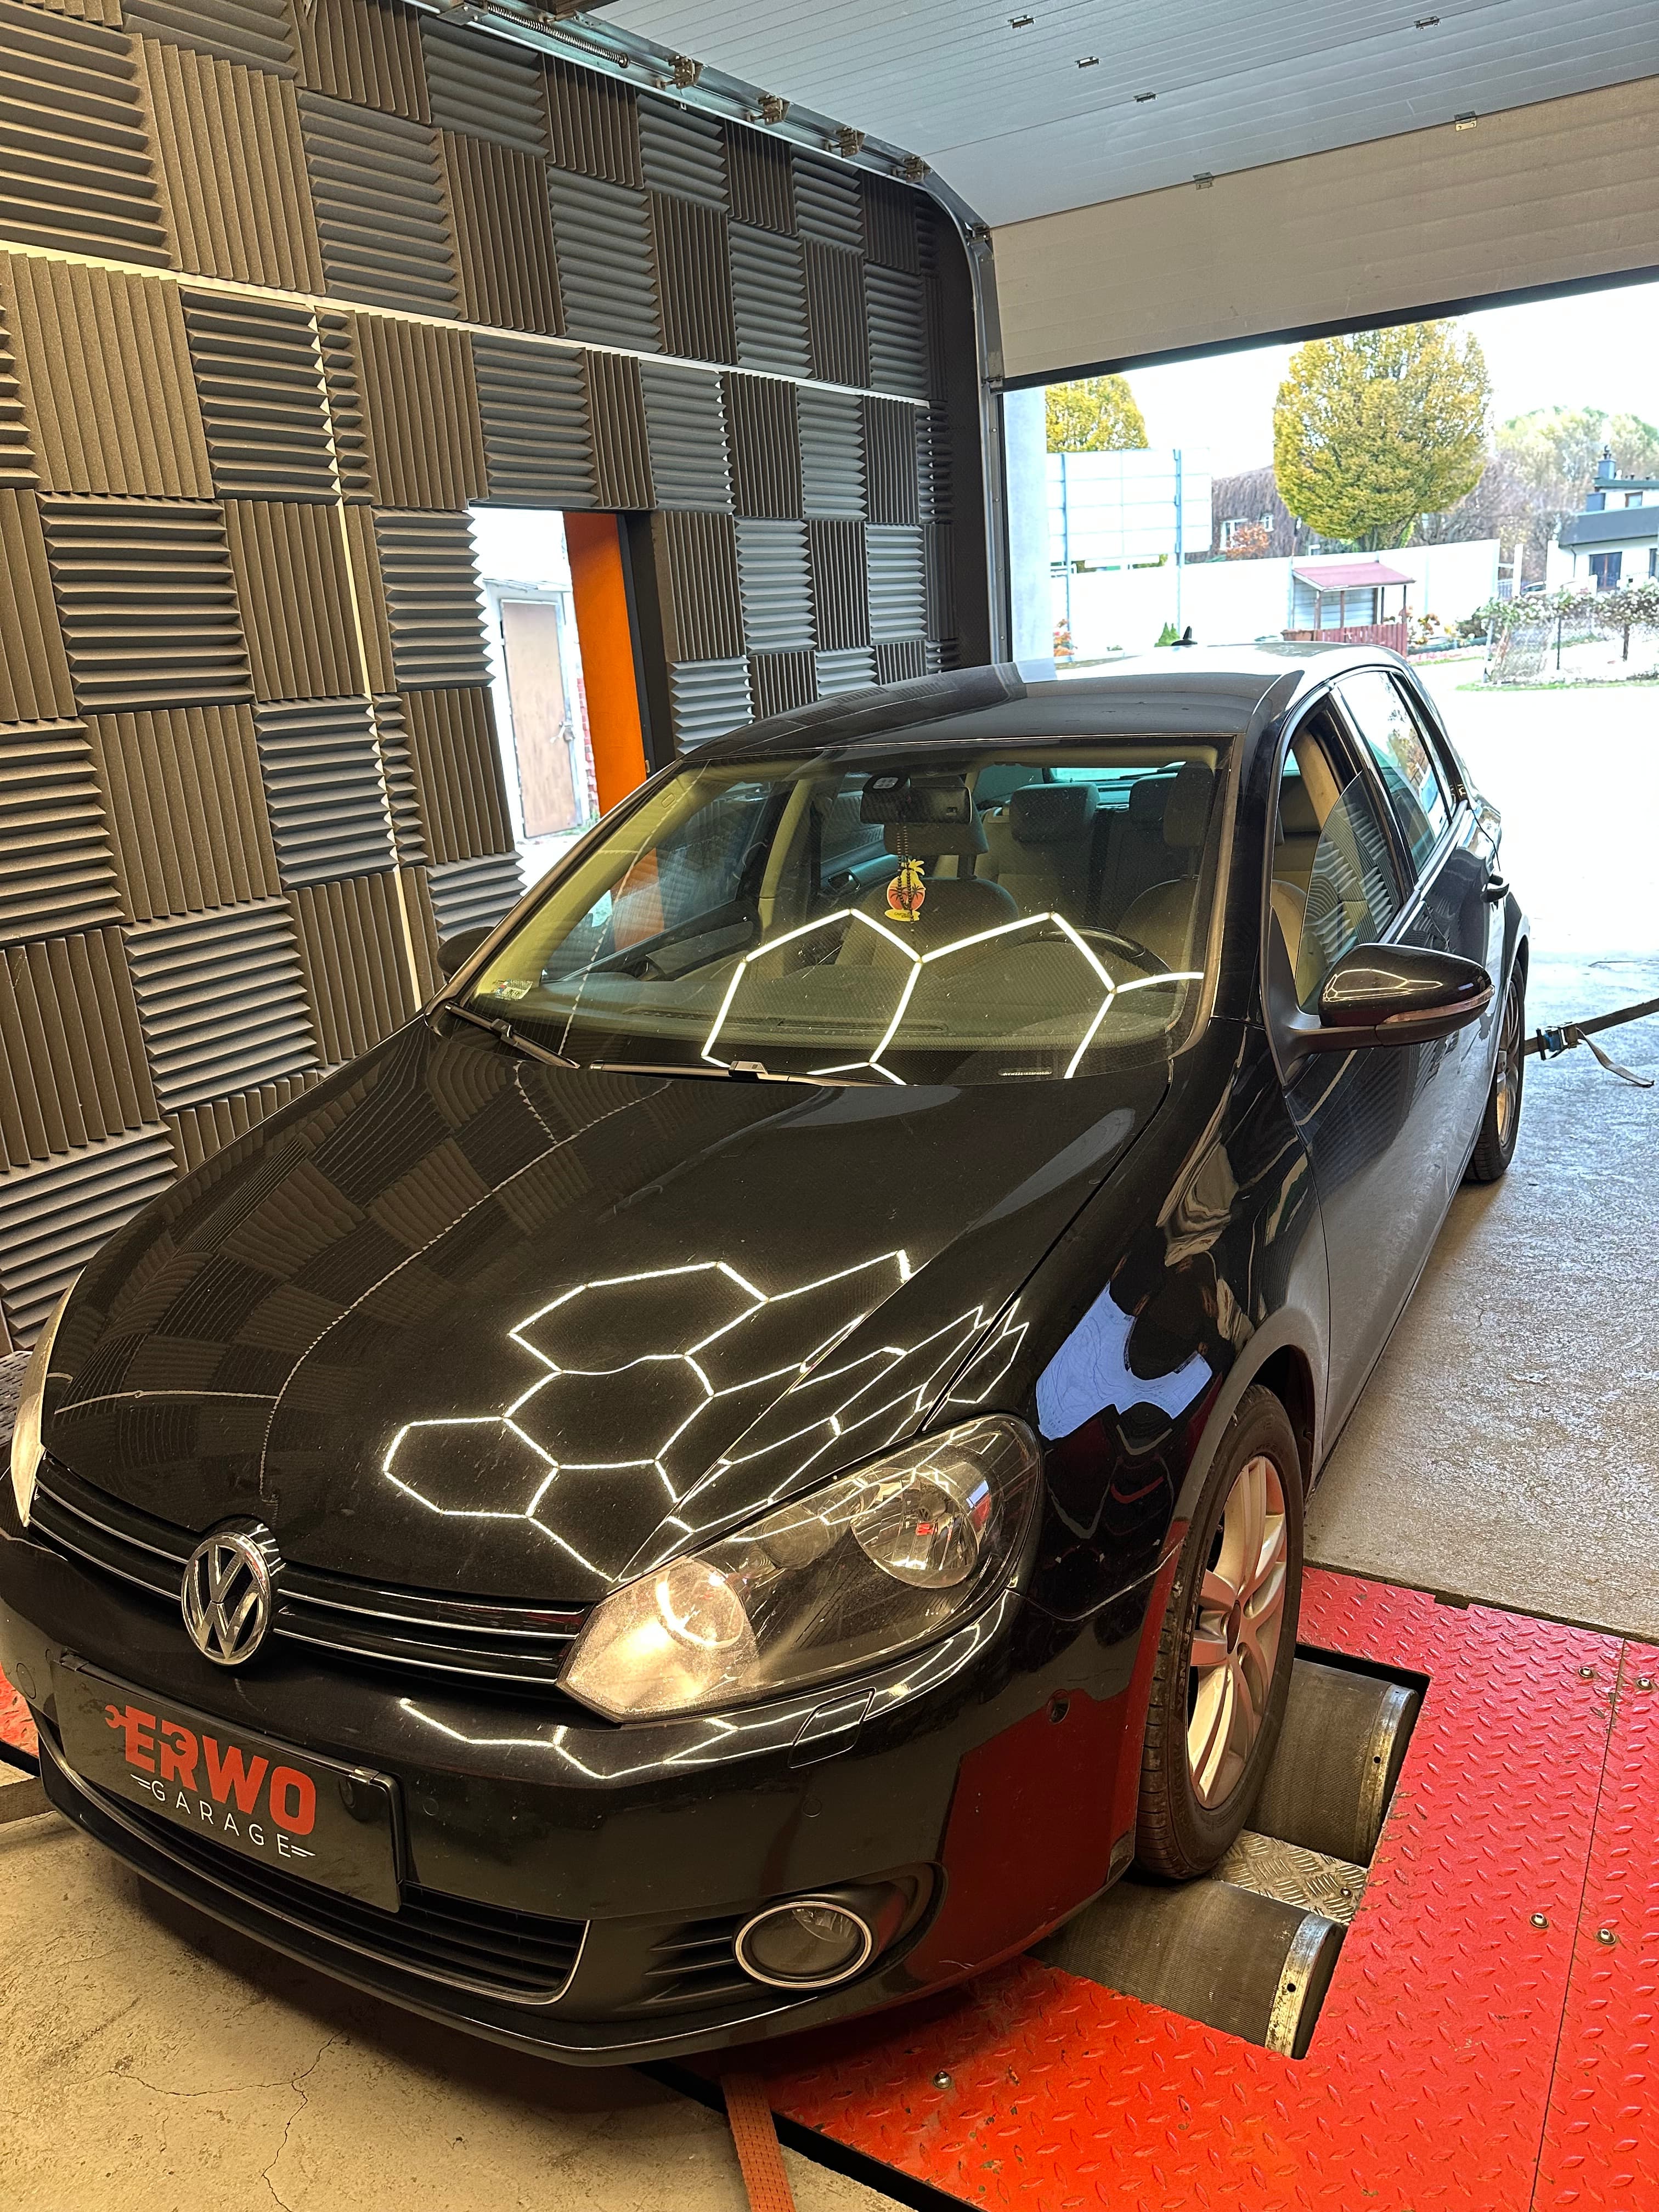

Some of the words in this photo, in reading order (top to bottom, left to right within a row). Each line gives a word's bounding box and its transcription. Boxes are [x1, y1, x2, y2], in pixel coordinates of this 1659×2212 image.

[184, 1541, 267, 1661] VW
[125, 1705, 316, 1835] ERWO
[151, 1780, 291, 1858] GARAGE
